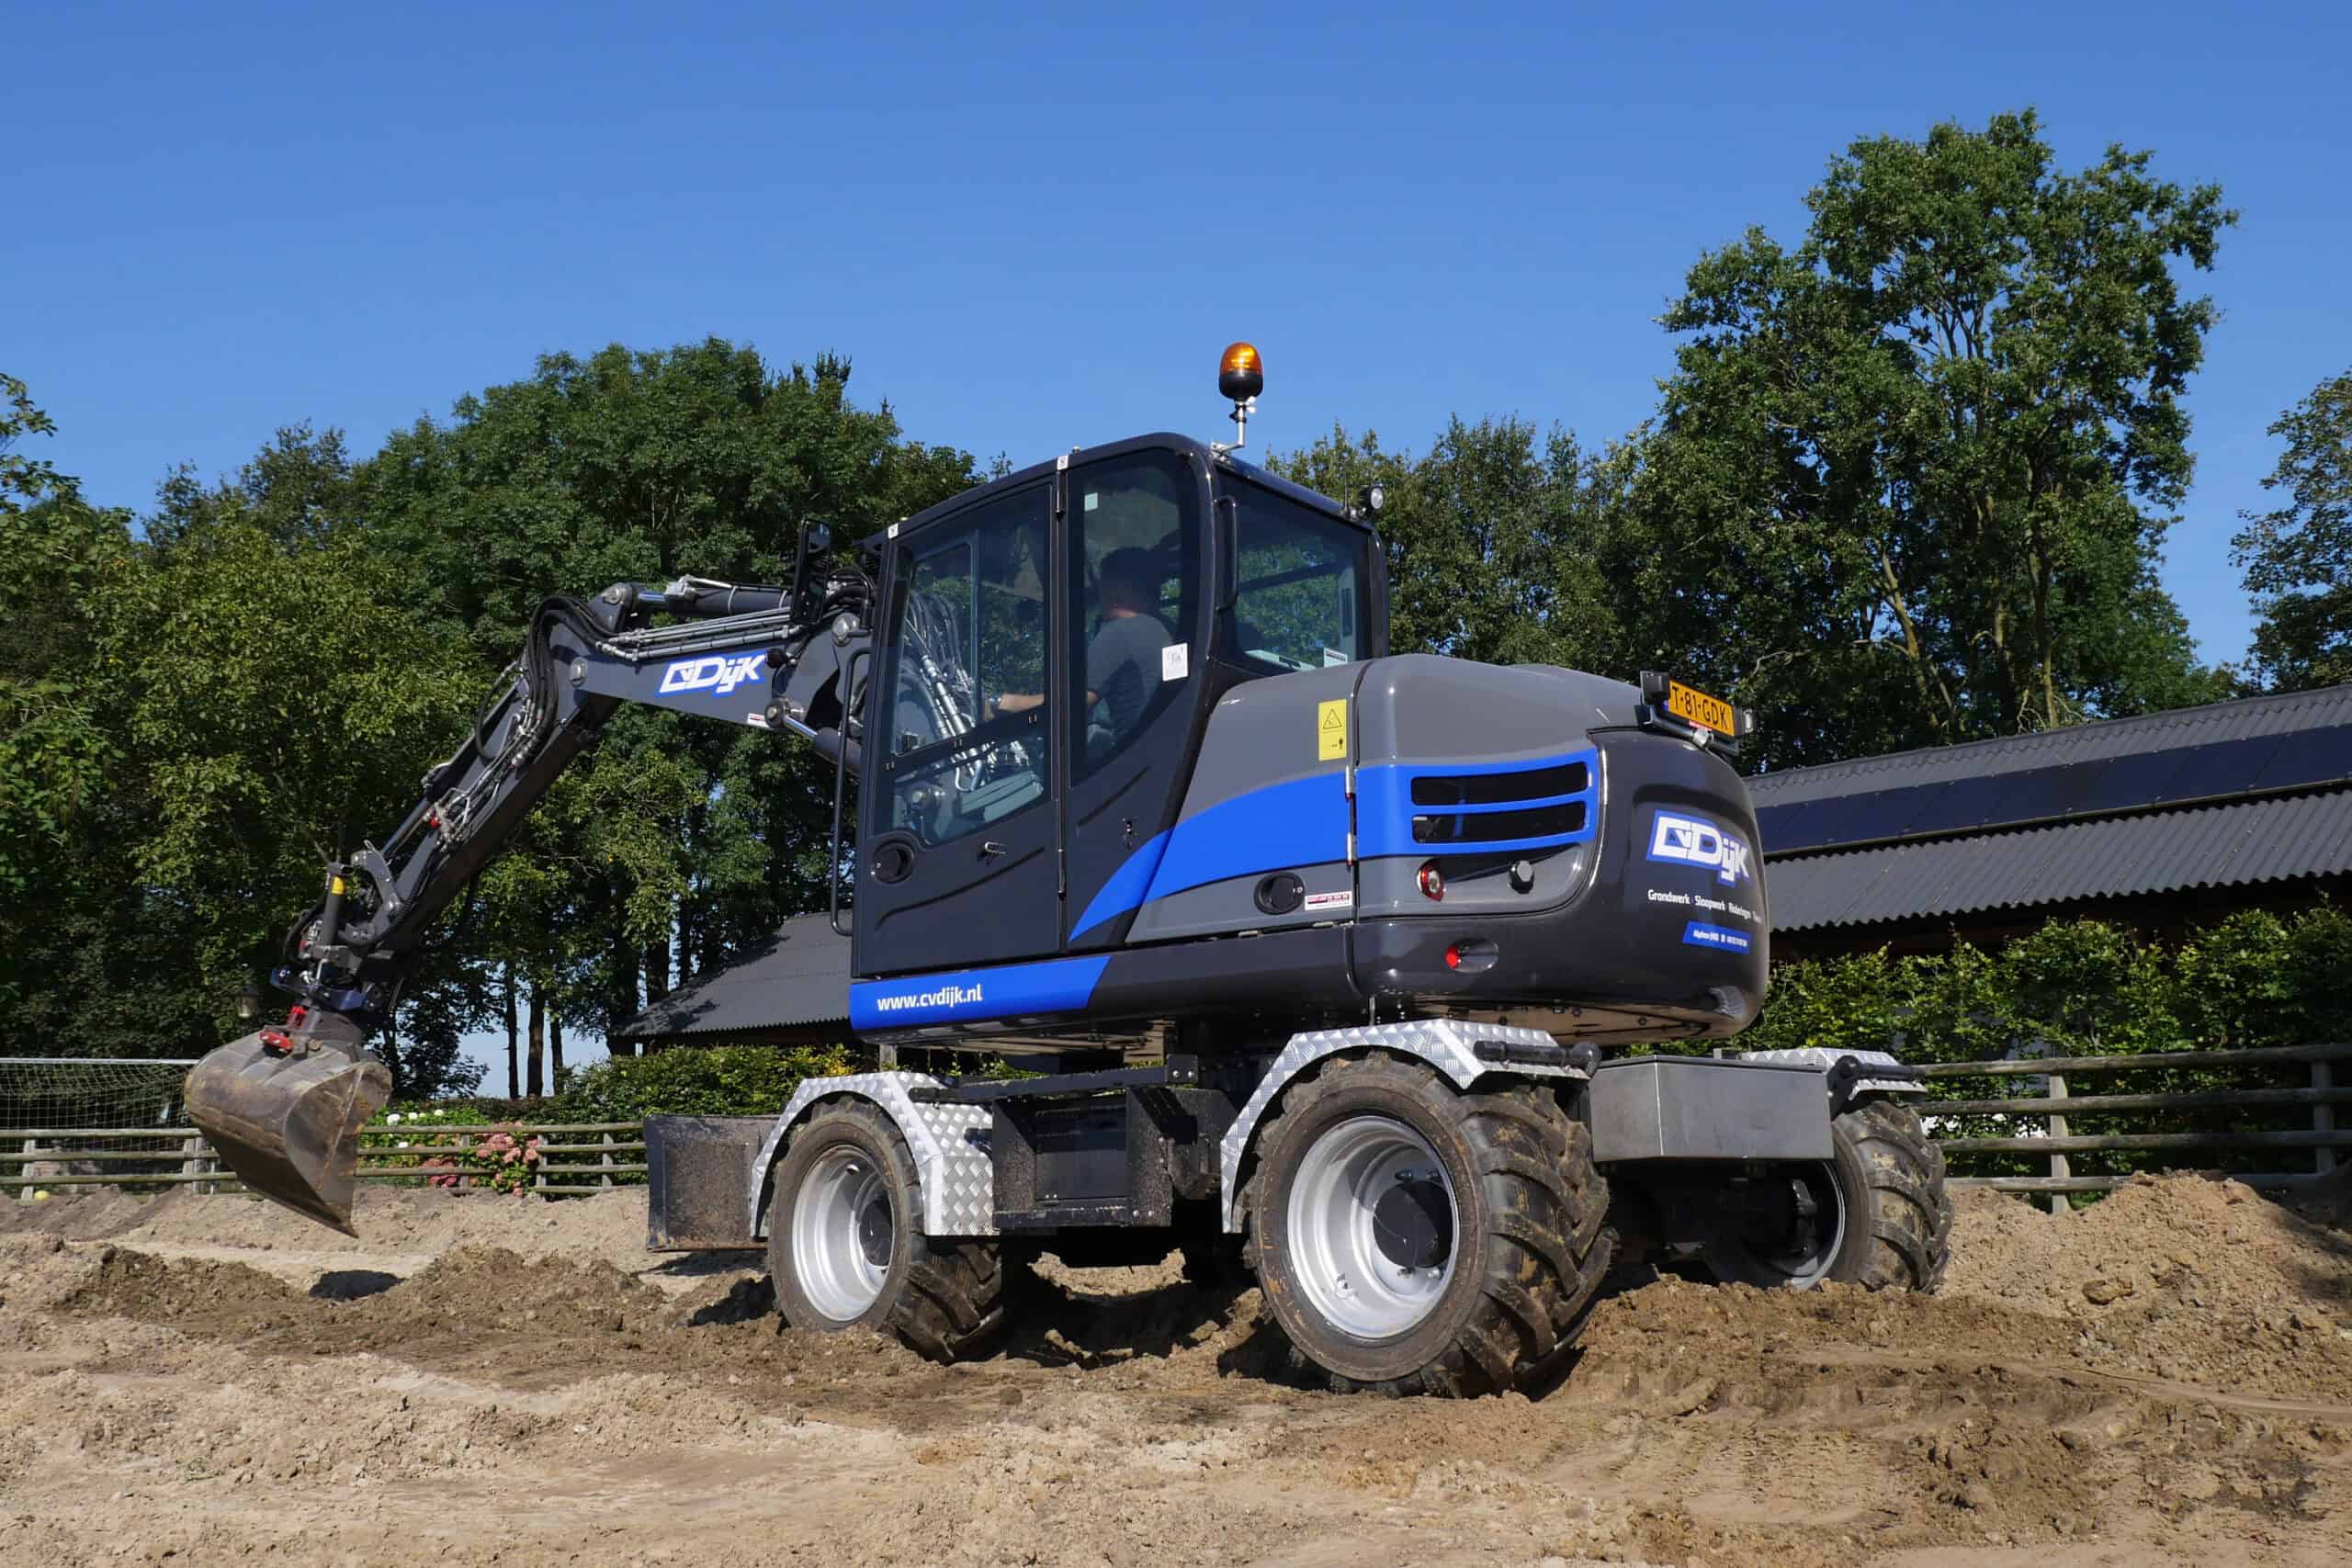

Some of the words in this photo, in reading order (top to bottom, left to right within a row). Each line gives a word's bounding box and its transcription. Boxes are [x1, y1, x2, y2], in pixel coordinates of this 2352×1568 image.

[1671, 686, 1727, 730] T-81-GDK
[1647, 888, 1690, 905] Grondwerk
[876, 984, 983, 1010] www.cvdijk.nl
